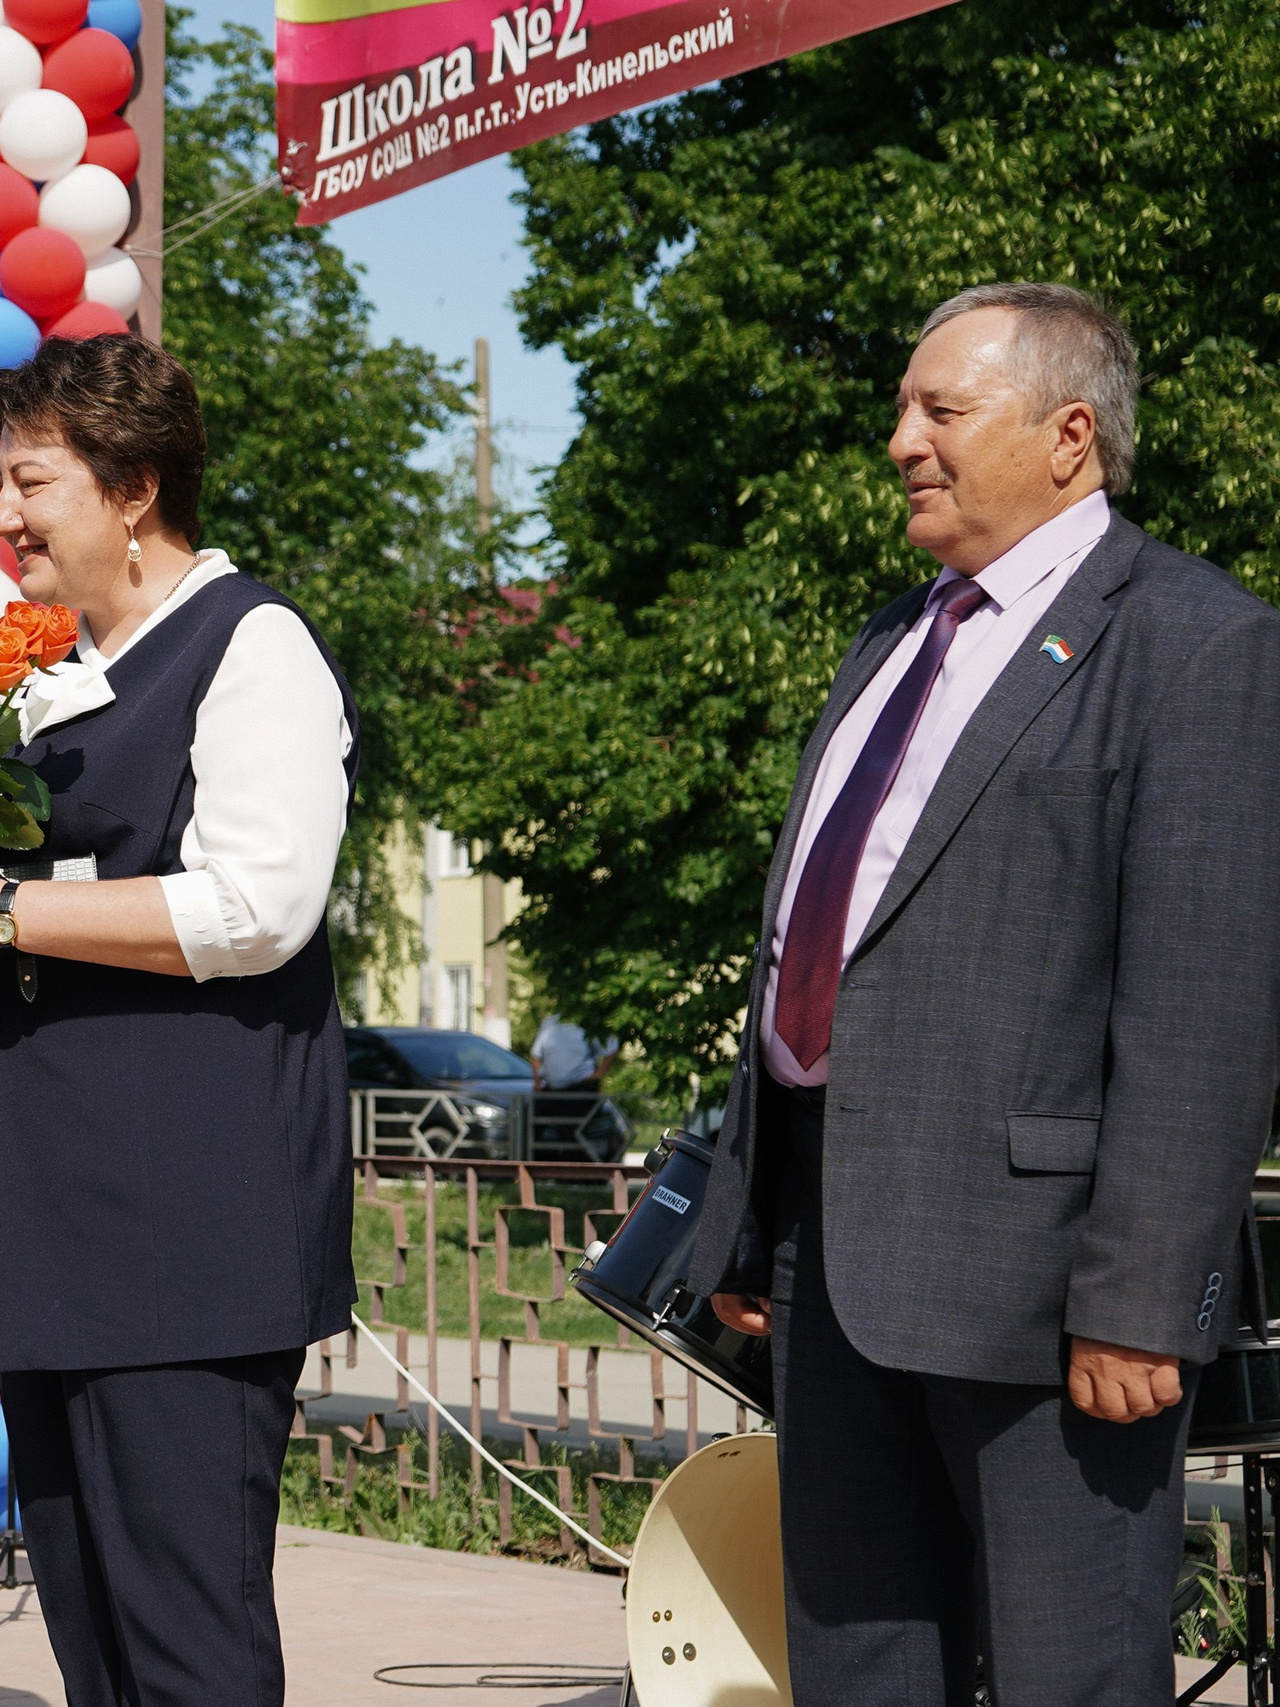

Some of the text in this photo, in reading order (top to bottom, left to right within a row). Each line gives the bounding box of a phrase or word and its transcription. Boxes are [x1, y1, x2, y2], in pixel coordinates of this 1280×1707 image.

[311, 154, 368, 202] ГБОУ
[371, 131, 413, 181] СОШ
[416, 113, 451, 159] №2
[515, 7, 734, 120] Усть-Кинельский
[315, 0, 587, 163] Школа №2
[654, 1188, 688, 1212] BRAHNER
